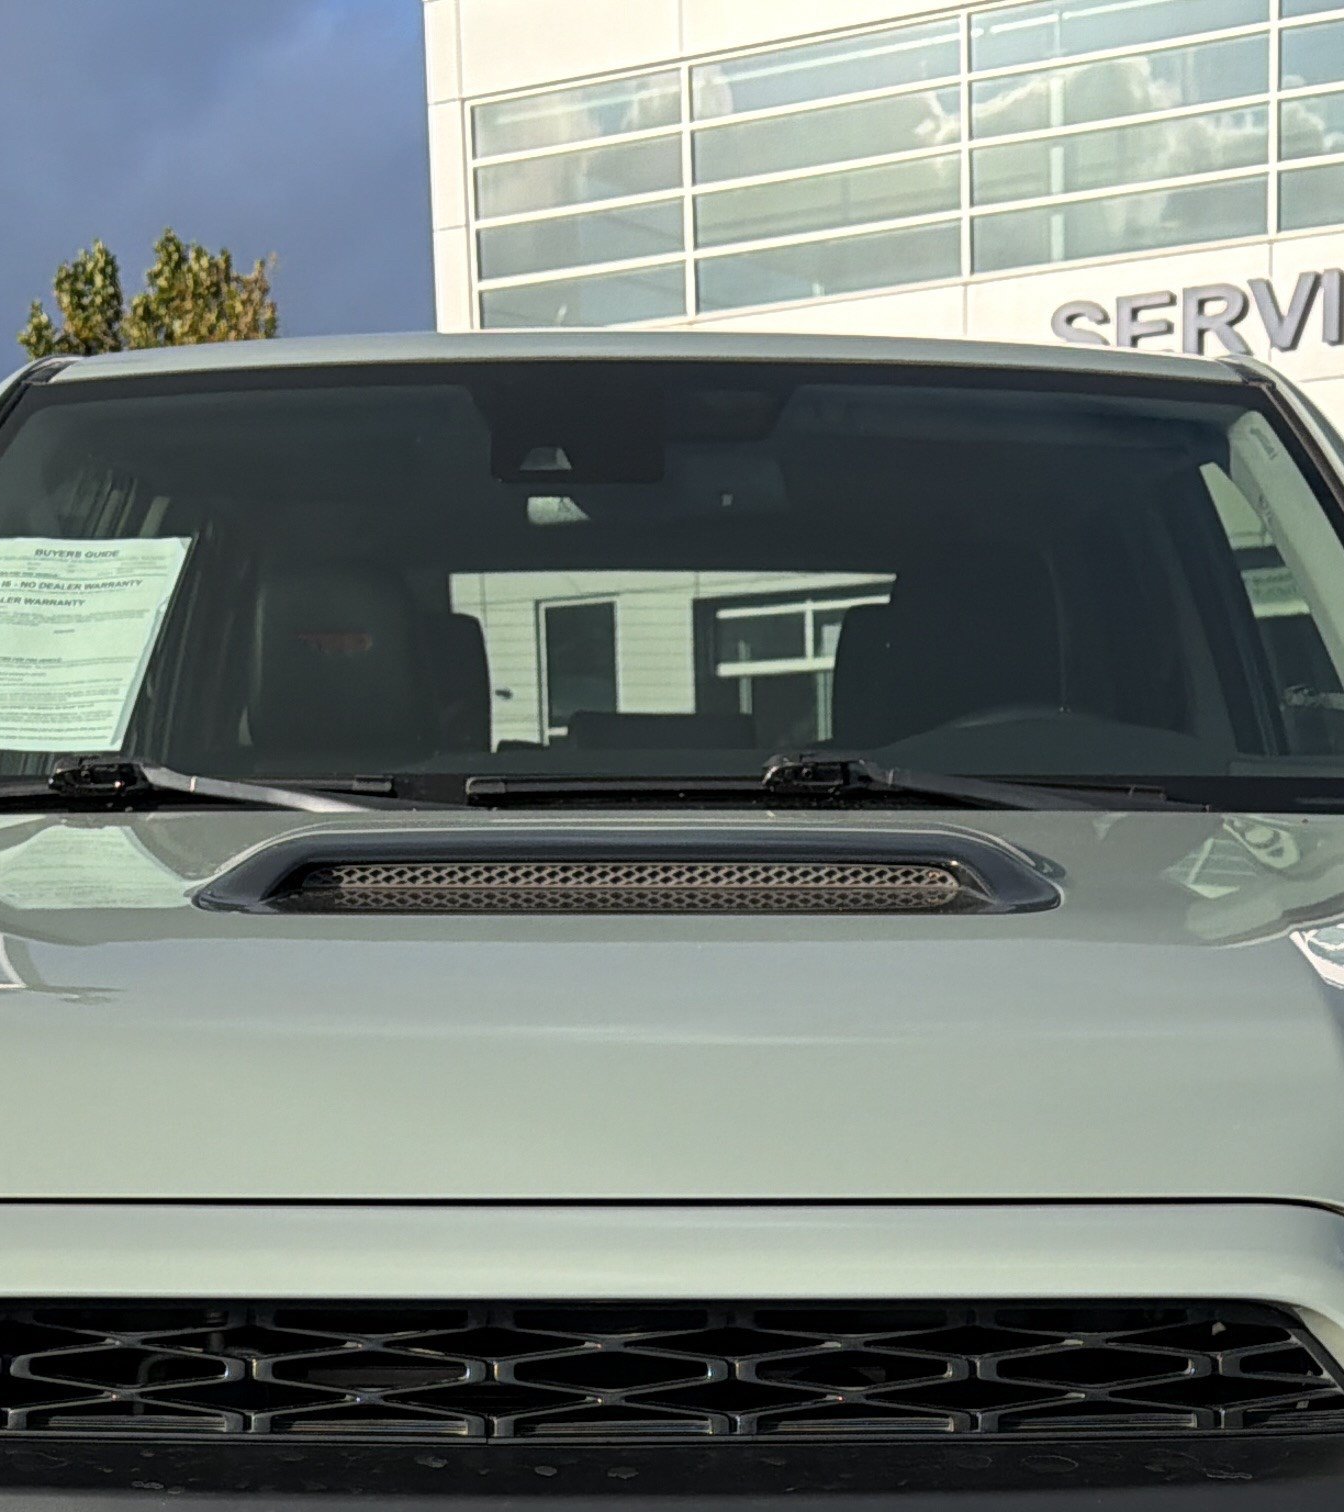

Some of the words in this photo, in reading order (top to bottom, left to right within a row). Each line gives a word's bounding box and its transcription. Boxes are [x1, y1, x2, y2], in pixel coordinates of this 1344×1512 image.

[20, 581, 37, 589] NO
[38, 582, 82, 591] DEALER
[84, 579, 144, 591] WARRANTY
[23, 597, 86, 606] WARRANTY
